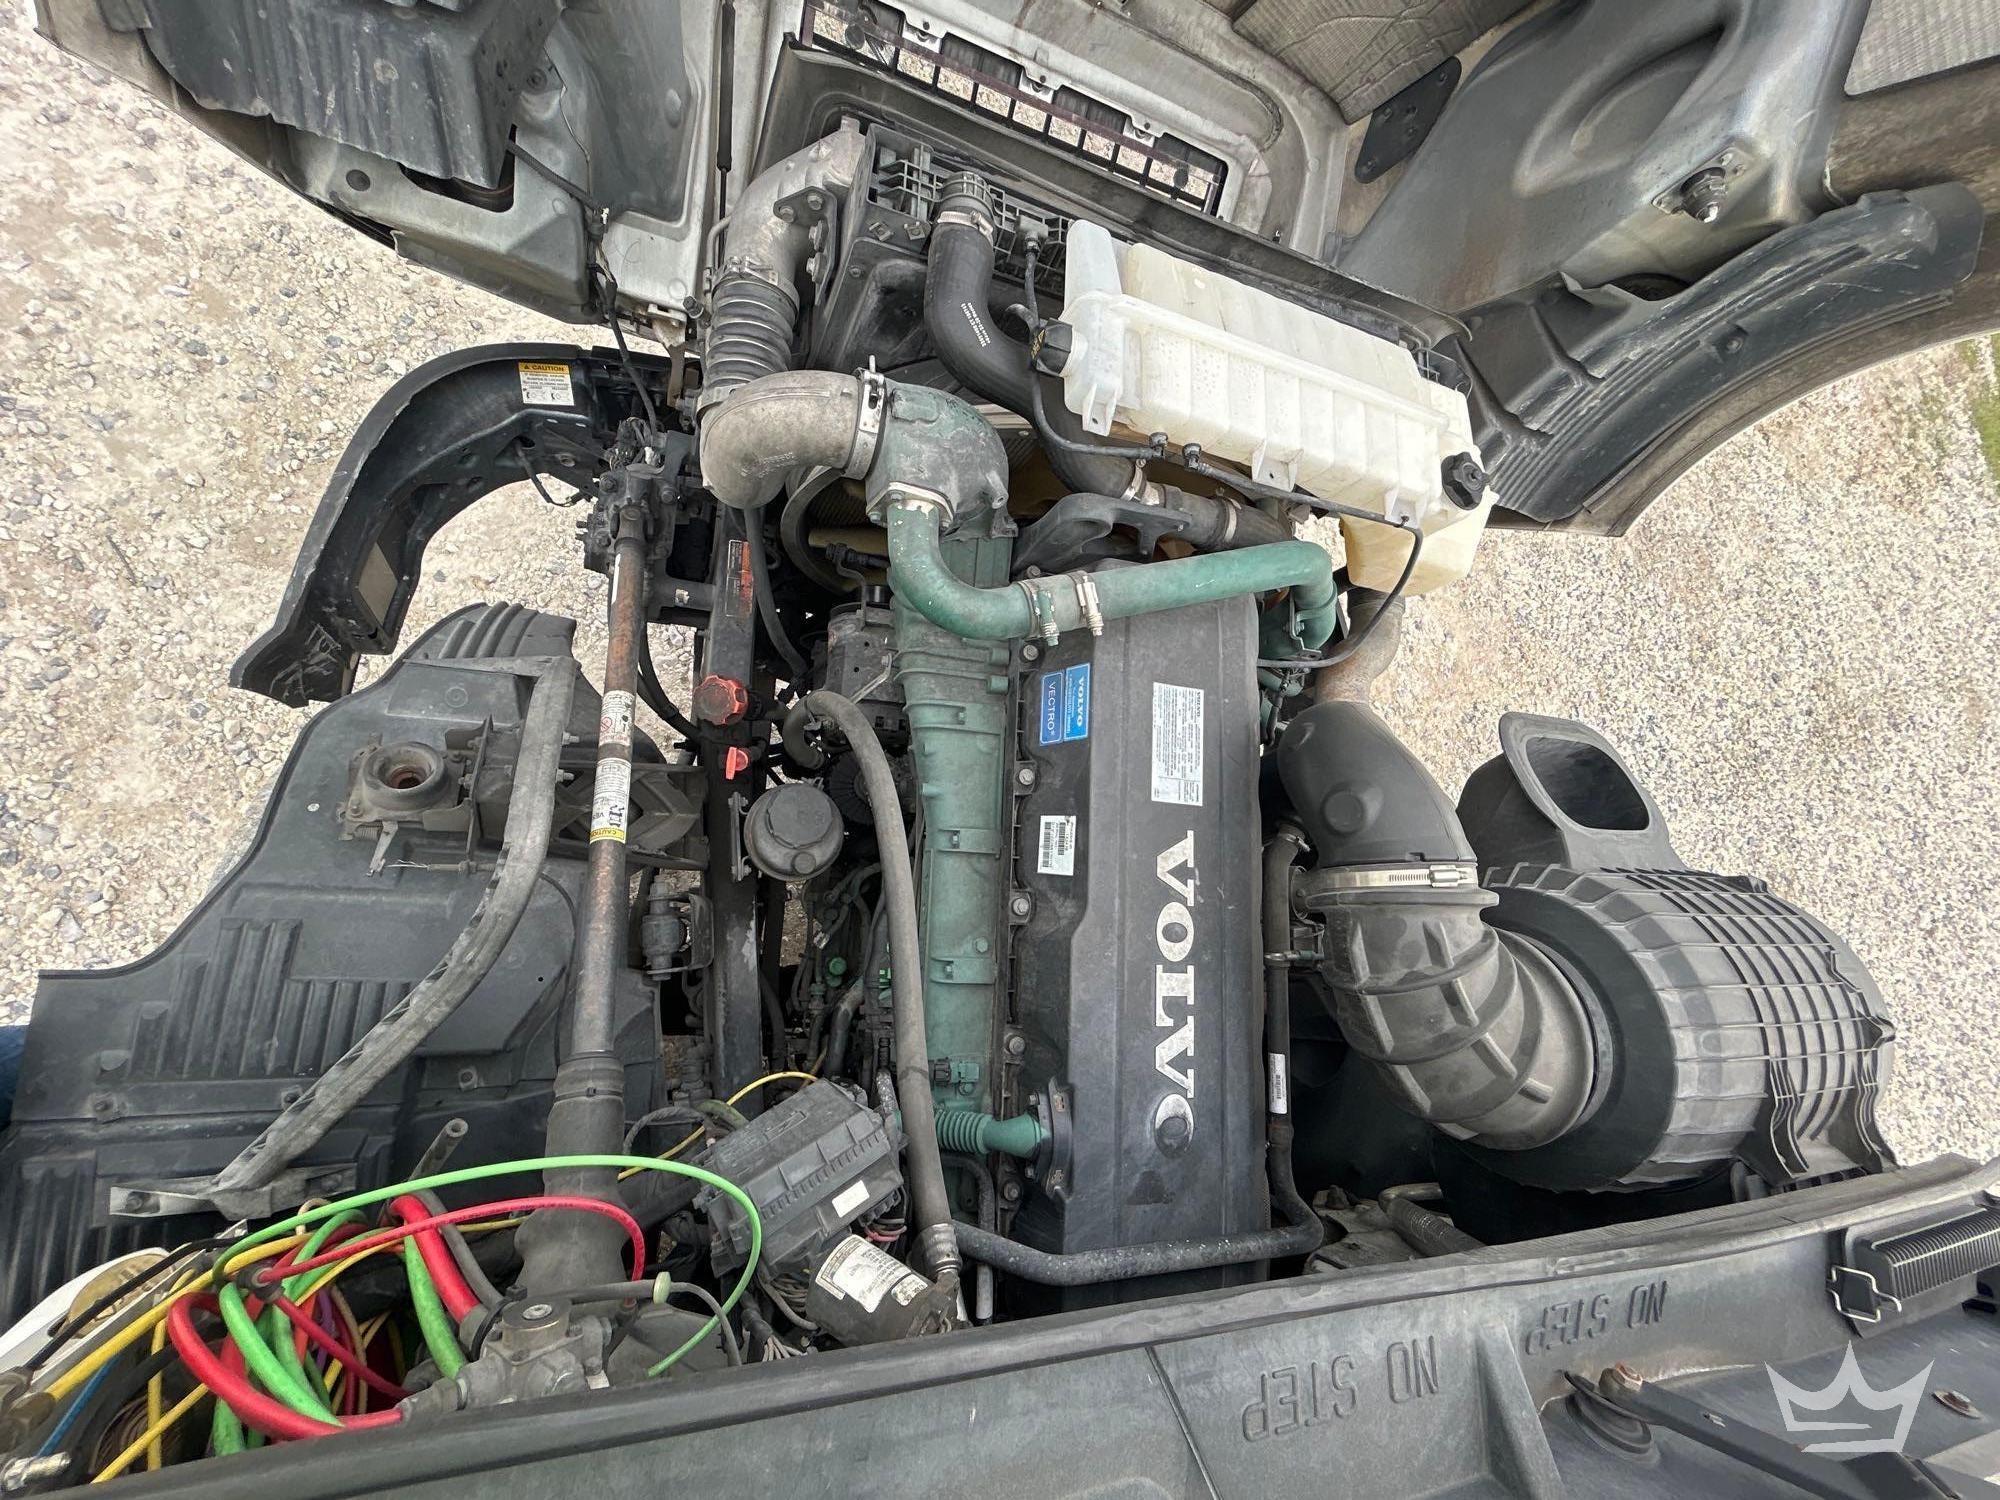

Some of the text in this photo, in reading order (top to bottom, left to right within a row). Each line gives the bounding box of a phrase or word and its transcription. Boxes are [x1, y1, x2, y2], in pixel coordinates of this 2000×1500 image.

[1076, 675, 1085, 727] VOLVO
[1155, 829, 1195, 1154] VOLVO
[1525, 1281, 1667, 1356] NO STEP
[1241, 1336, 1439, 1442] NO STEP
